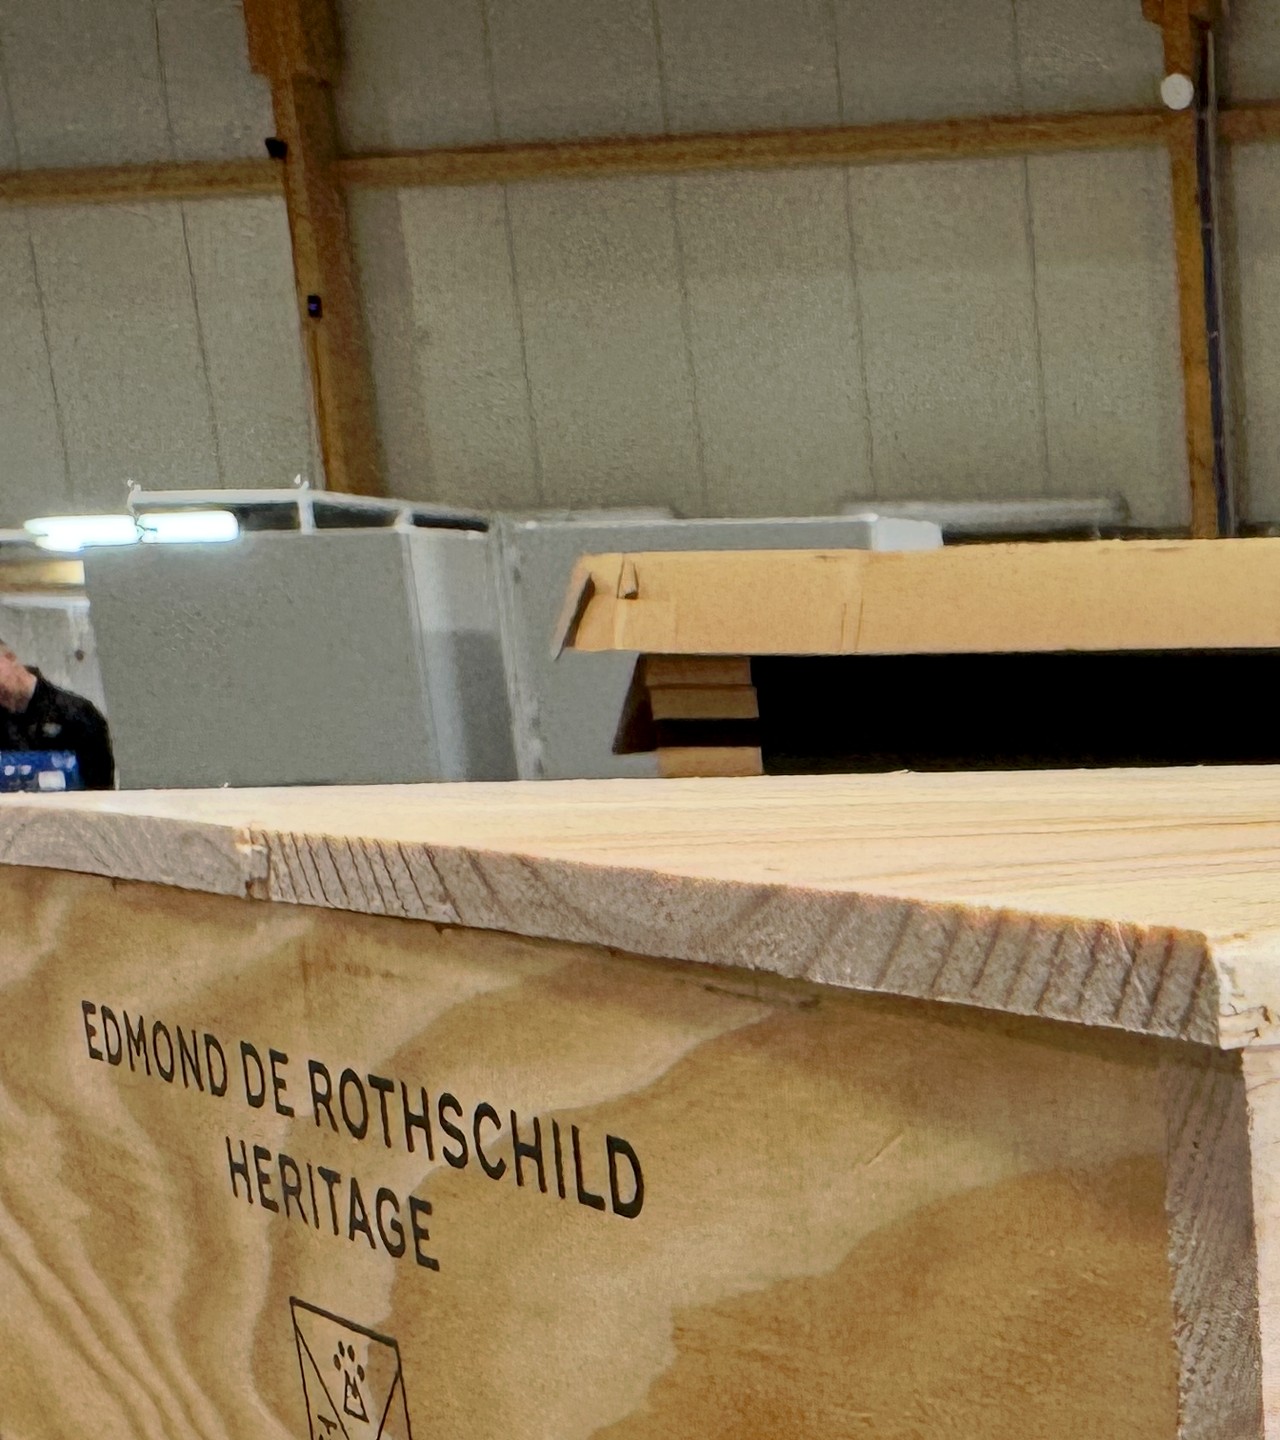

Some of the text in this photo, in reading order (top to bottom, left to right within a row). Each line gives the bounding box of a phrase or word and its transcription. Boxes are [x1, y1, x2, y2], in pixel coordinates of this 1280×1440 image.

[81, 1000, 645, 1220] EDMOND DE ROTHSCHILD
[225, 1136, 440, 1271] HERITAGE
